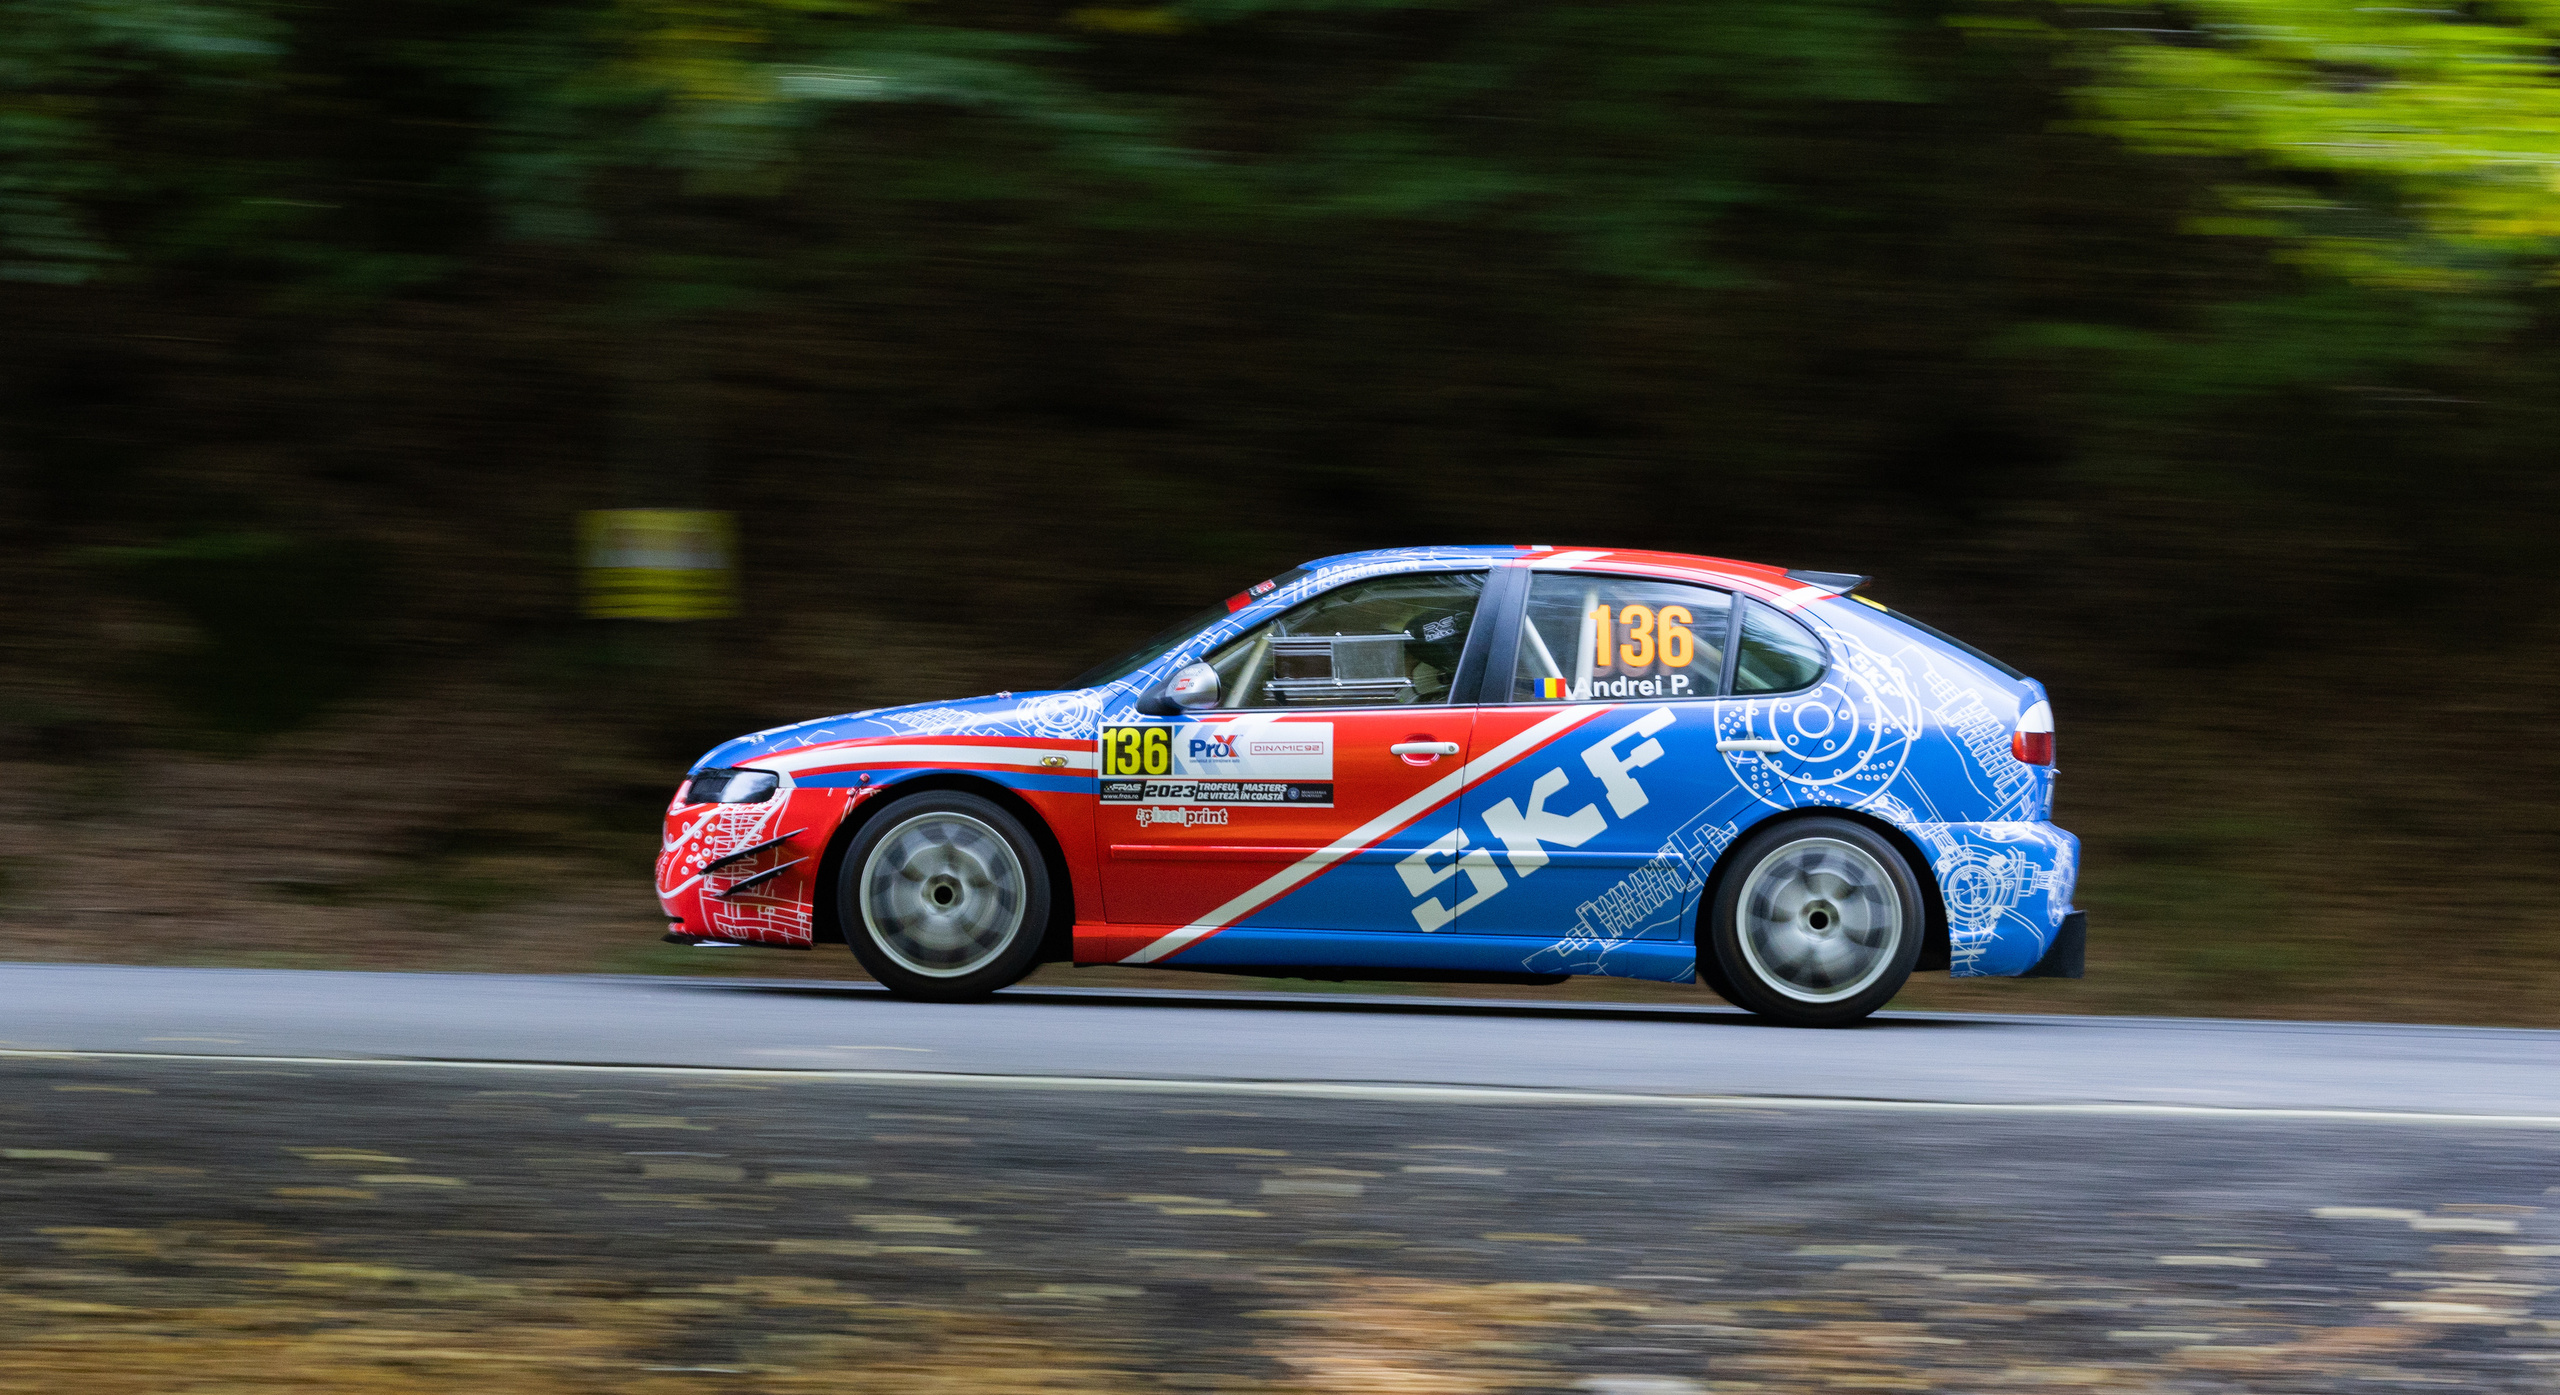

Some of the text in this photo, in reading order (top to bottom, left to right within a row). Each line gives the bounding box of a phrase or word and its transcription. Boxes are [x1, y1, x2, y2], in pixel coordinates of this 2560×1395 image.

[1589, 604, 1694, 668] 136
[1572, 674, 1694, 698] Andrei P.
[1849, 652, 1903, 698] SKF
[1102, 727, 1168, 776] 136
[1253, 744, 1320, 752] DINAMIC92
[1144, 784, 1197, 798] 2023
[1197, 791, 1210, 800] DE
[1210, 790, 1240, 800] VITEZĂ
[1250, 790, 1284, 801] COASTĂ
[1198, 782, 1287, 793] TROFEUL MASTERS
[1395, 706, 1677, 933] SKF
